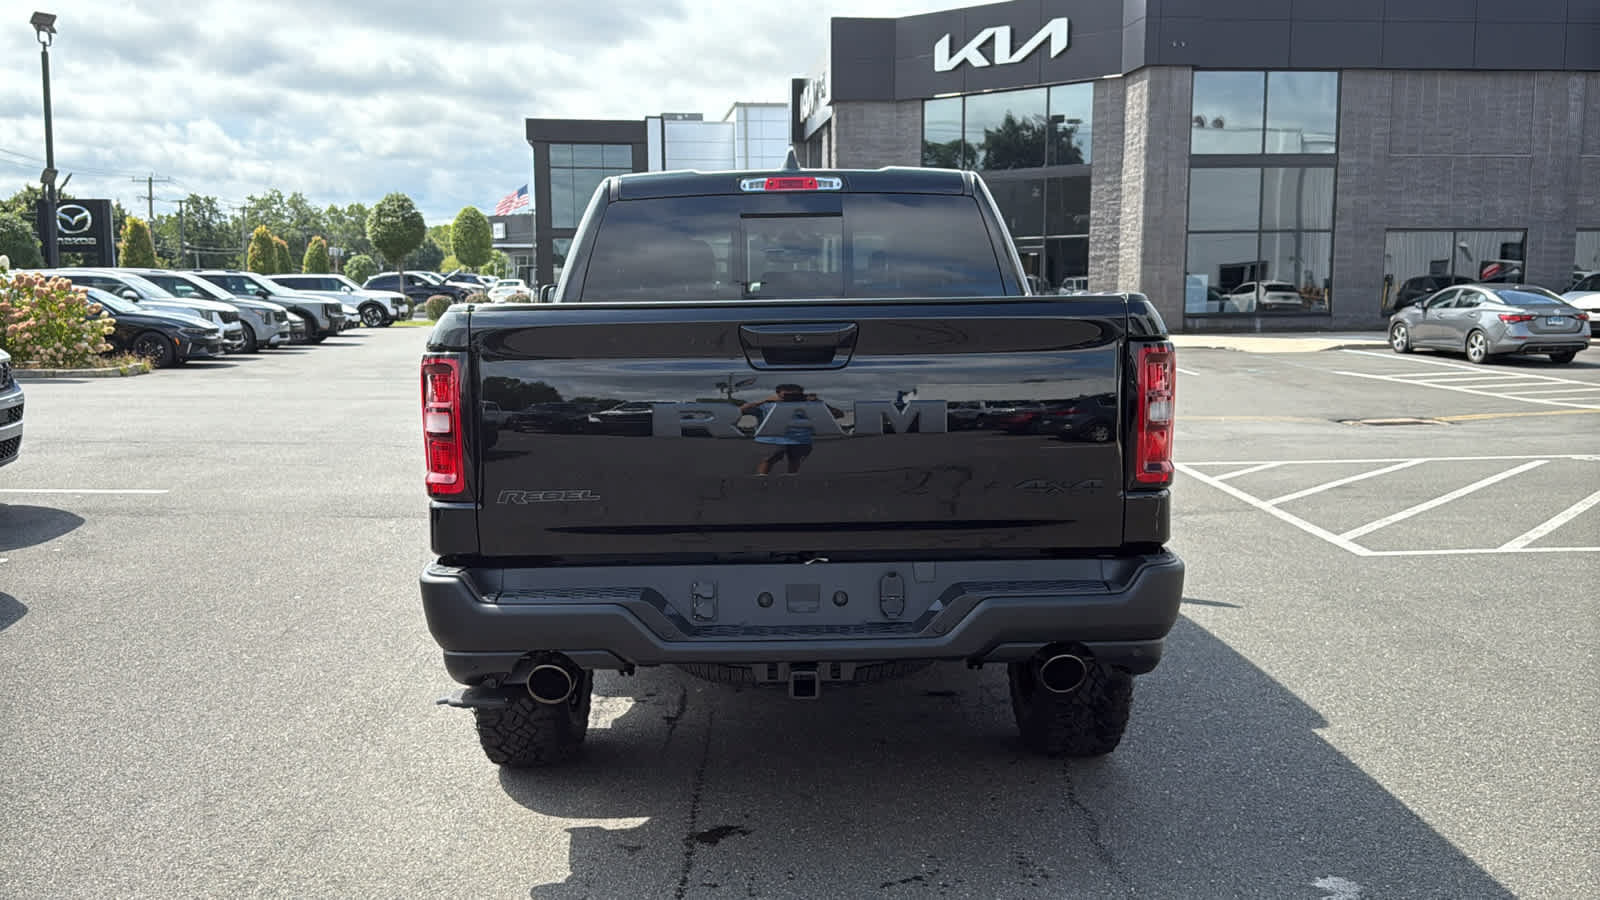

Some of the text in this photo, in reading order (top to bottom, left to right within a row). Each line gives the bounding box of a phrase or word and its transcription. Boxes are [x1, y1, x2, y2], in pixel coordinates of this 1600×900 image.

[934, 17, 1068, 72] KIA
[652, 400, 948, 437] RAM
[496, 489, 601, 504] REBEL
